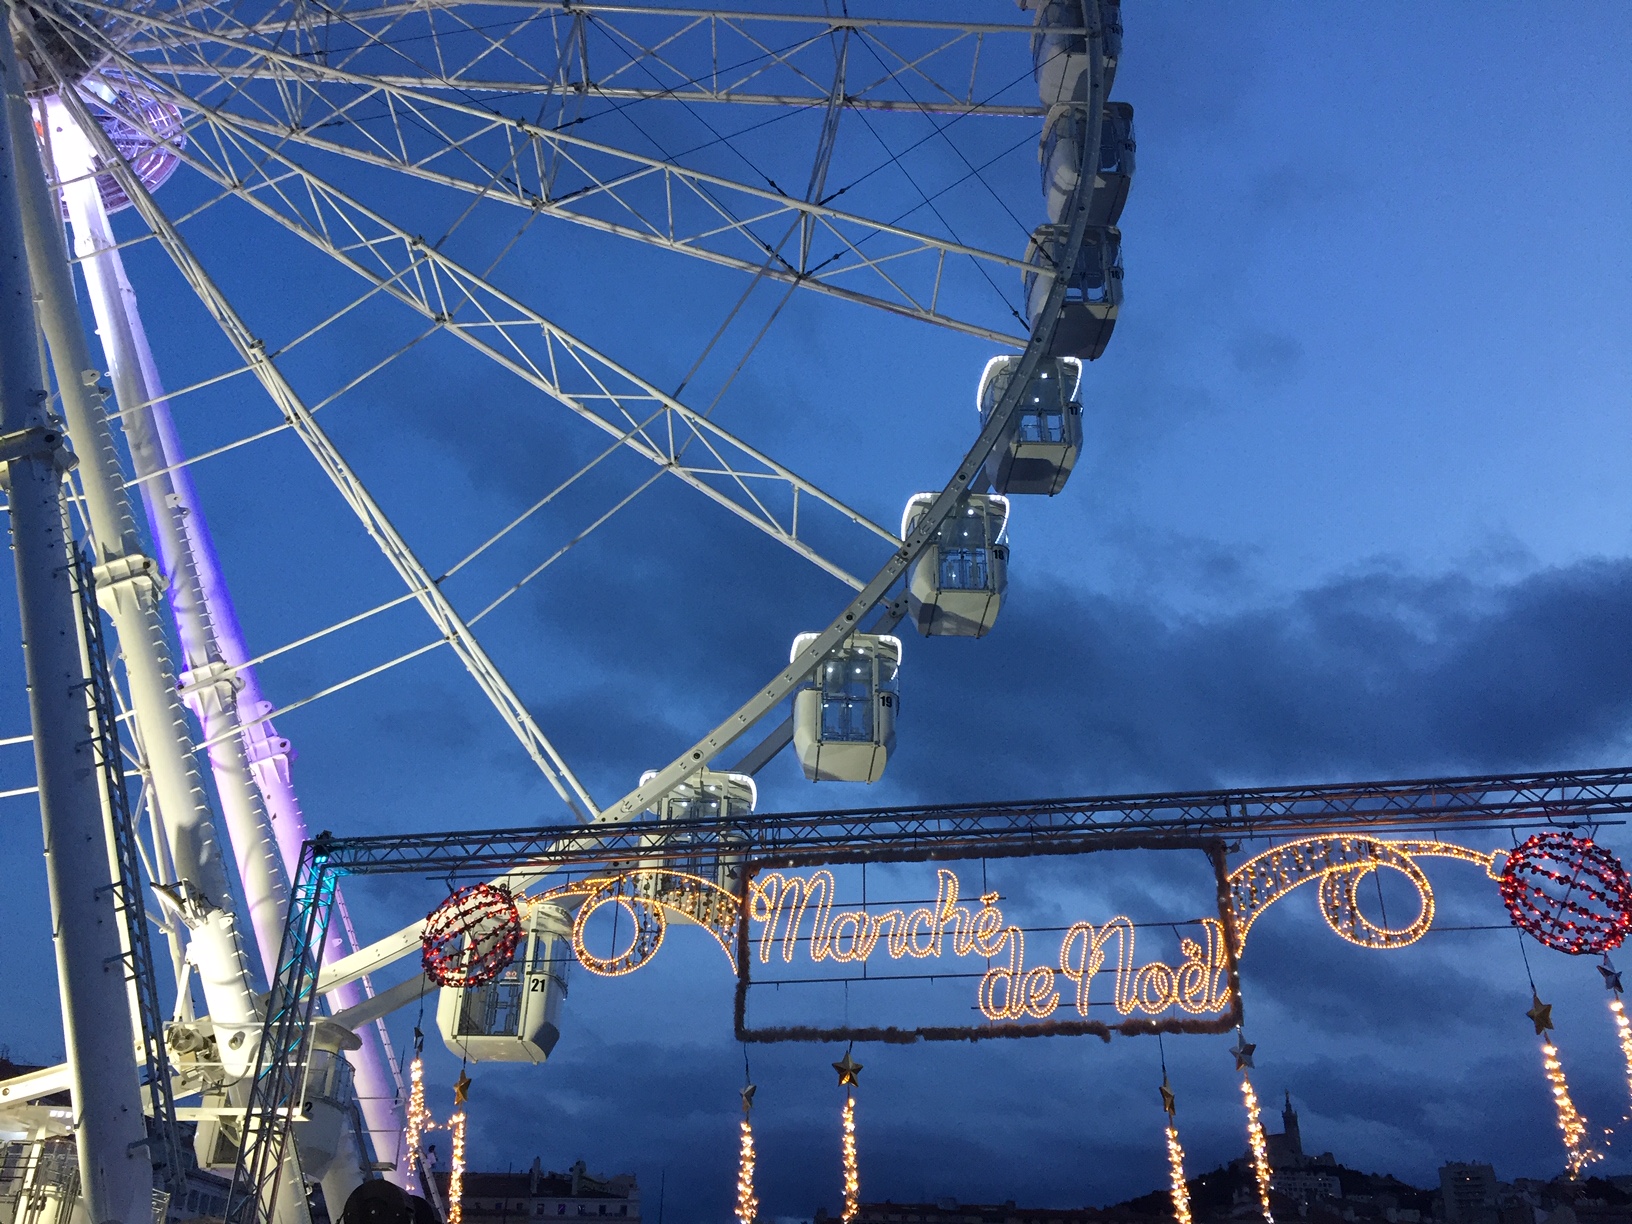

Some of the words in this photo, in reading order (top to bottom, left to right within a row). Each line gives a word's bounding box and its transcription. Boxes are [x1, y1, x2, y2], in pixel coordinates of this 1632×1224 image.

[1067, 406, 1078, 416] 17
[992, 549, 1004, 560] 18
[880, 695, 893, 708] 19
[748, 869, 1009, 963] Marché
[978, 925, 1060, 1020] de
[1059, 915, 1232, 1016] Noël
[530, 978, 546, 993] 21
